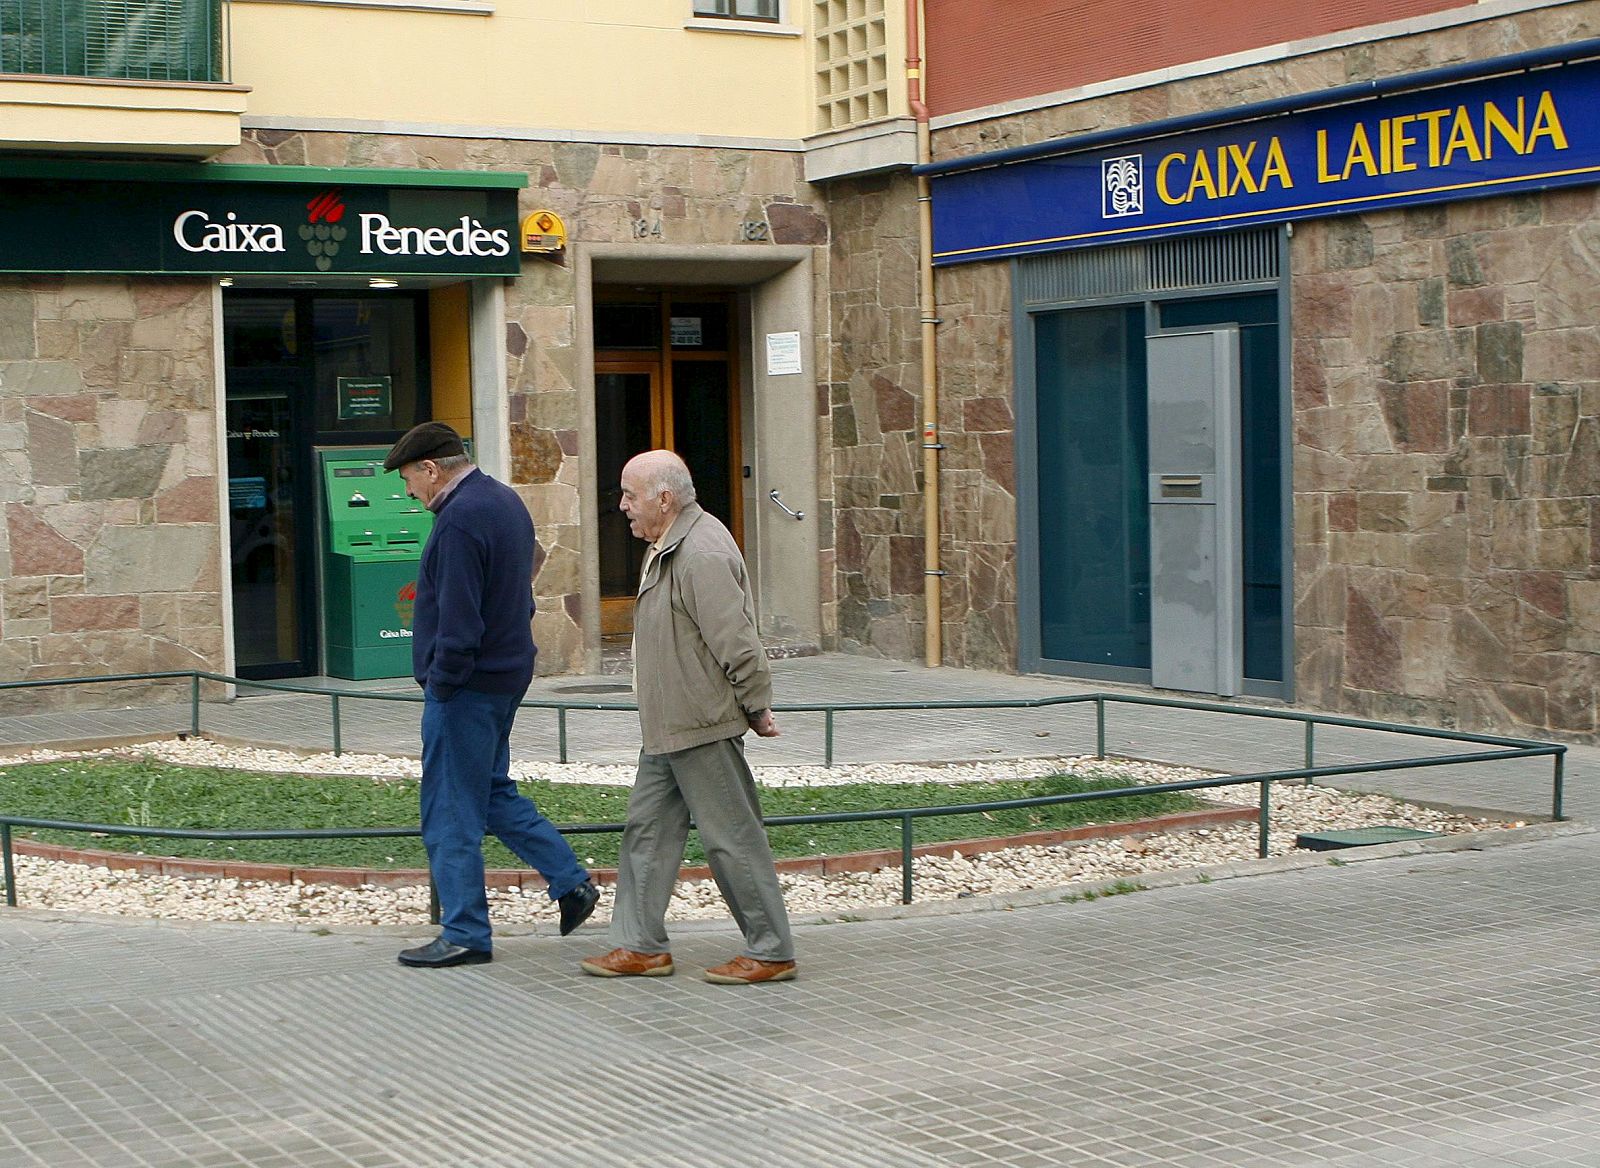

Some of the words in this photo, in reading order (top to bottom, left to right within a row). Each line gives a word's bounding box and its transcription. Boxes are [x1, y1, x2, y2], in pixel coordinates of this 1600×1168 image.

[1155, 136, 1294, 205] CAIXA
[1316, 90, 1569, 184] LAIETANA
[173, 210, 286, 254] Caixa
[358, 213, 510, 257] Penedès
[631, 217, 662, 240] 184
[739, 220, 768, 242] 182
